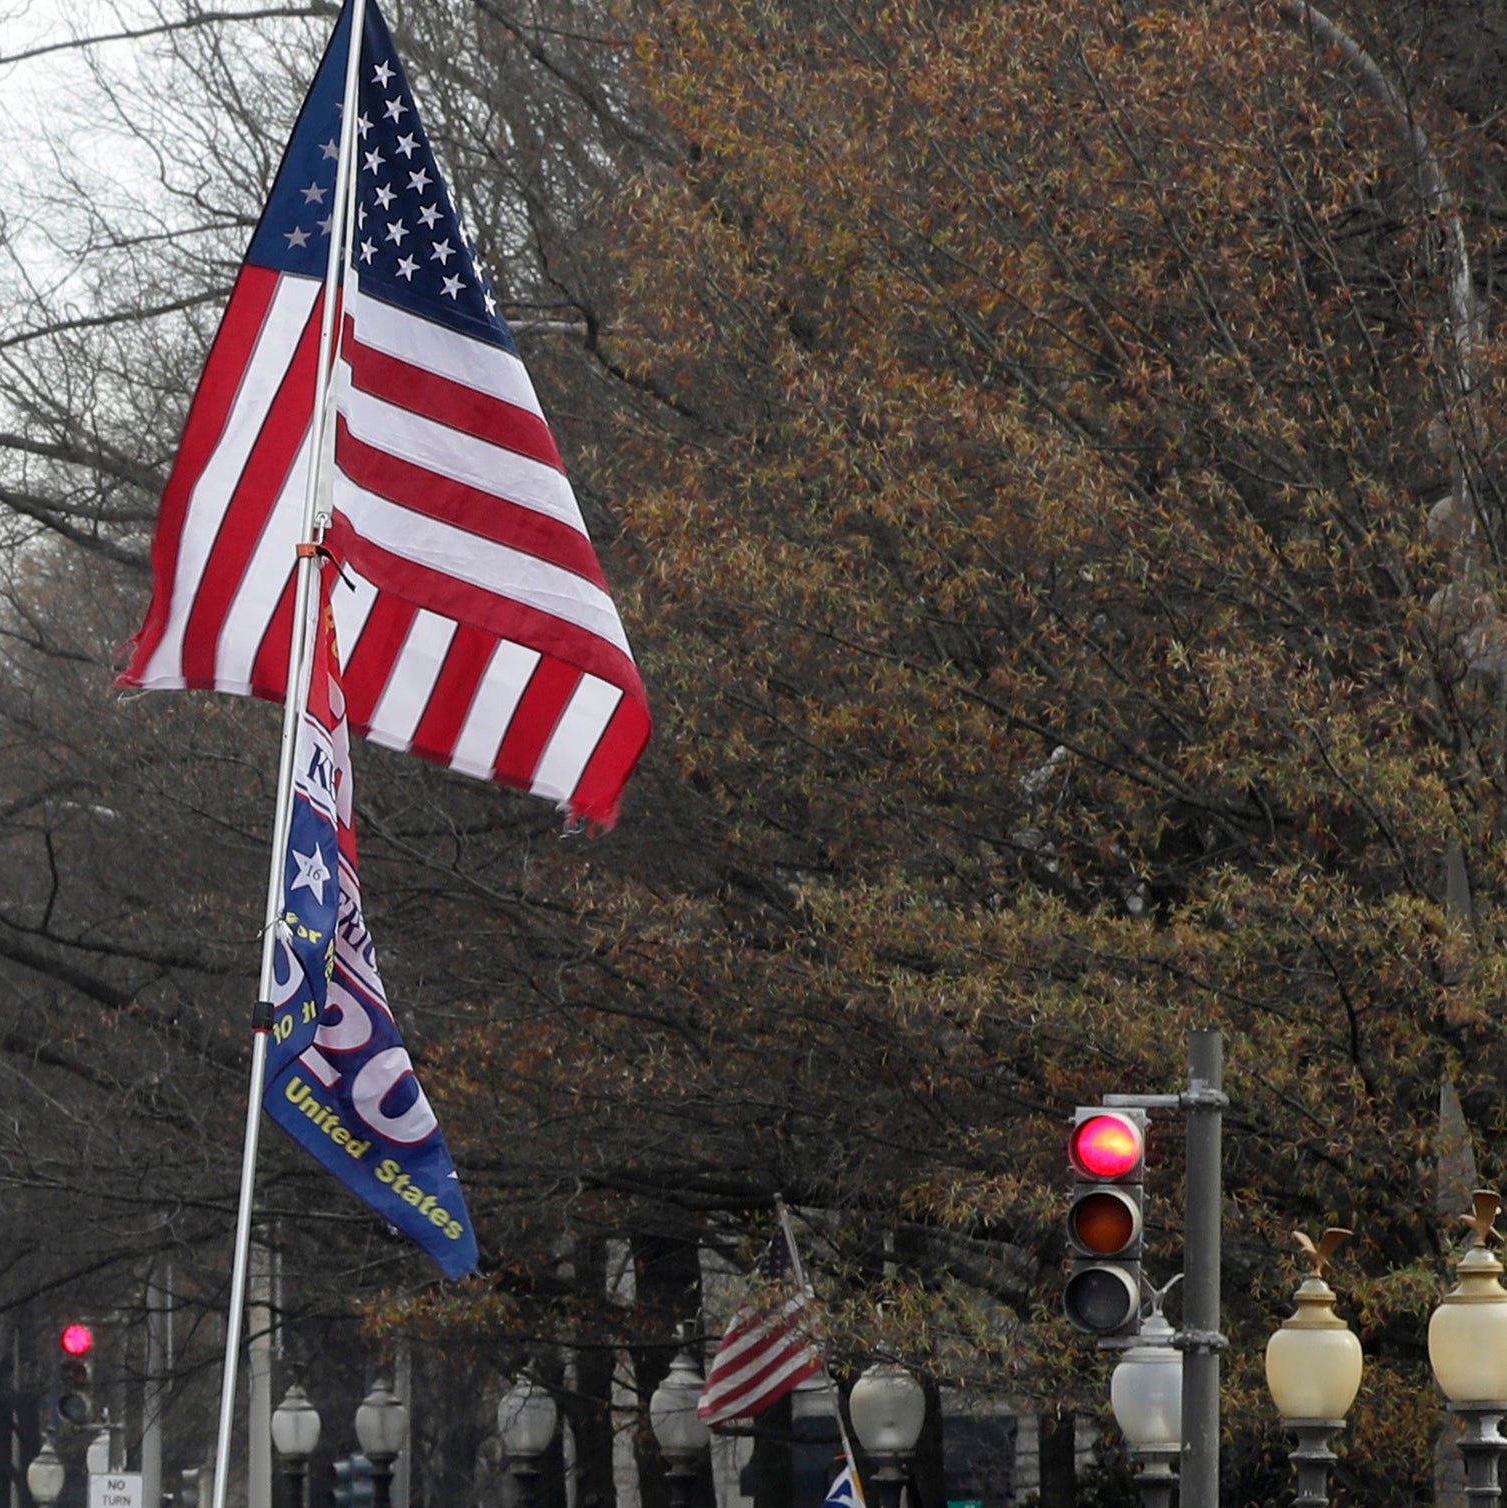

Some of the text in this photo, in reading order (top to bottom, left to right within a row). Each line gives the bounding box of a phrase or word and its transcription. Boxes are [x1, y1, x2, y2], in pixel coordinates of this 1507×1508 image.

[284, 1075, 465, 1242] United States
[107, 1480, 126, 1491] NO
[102, 1495, 132, 1507] TURN
